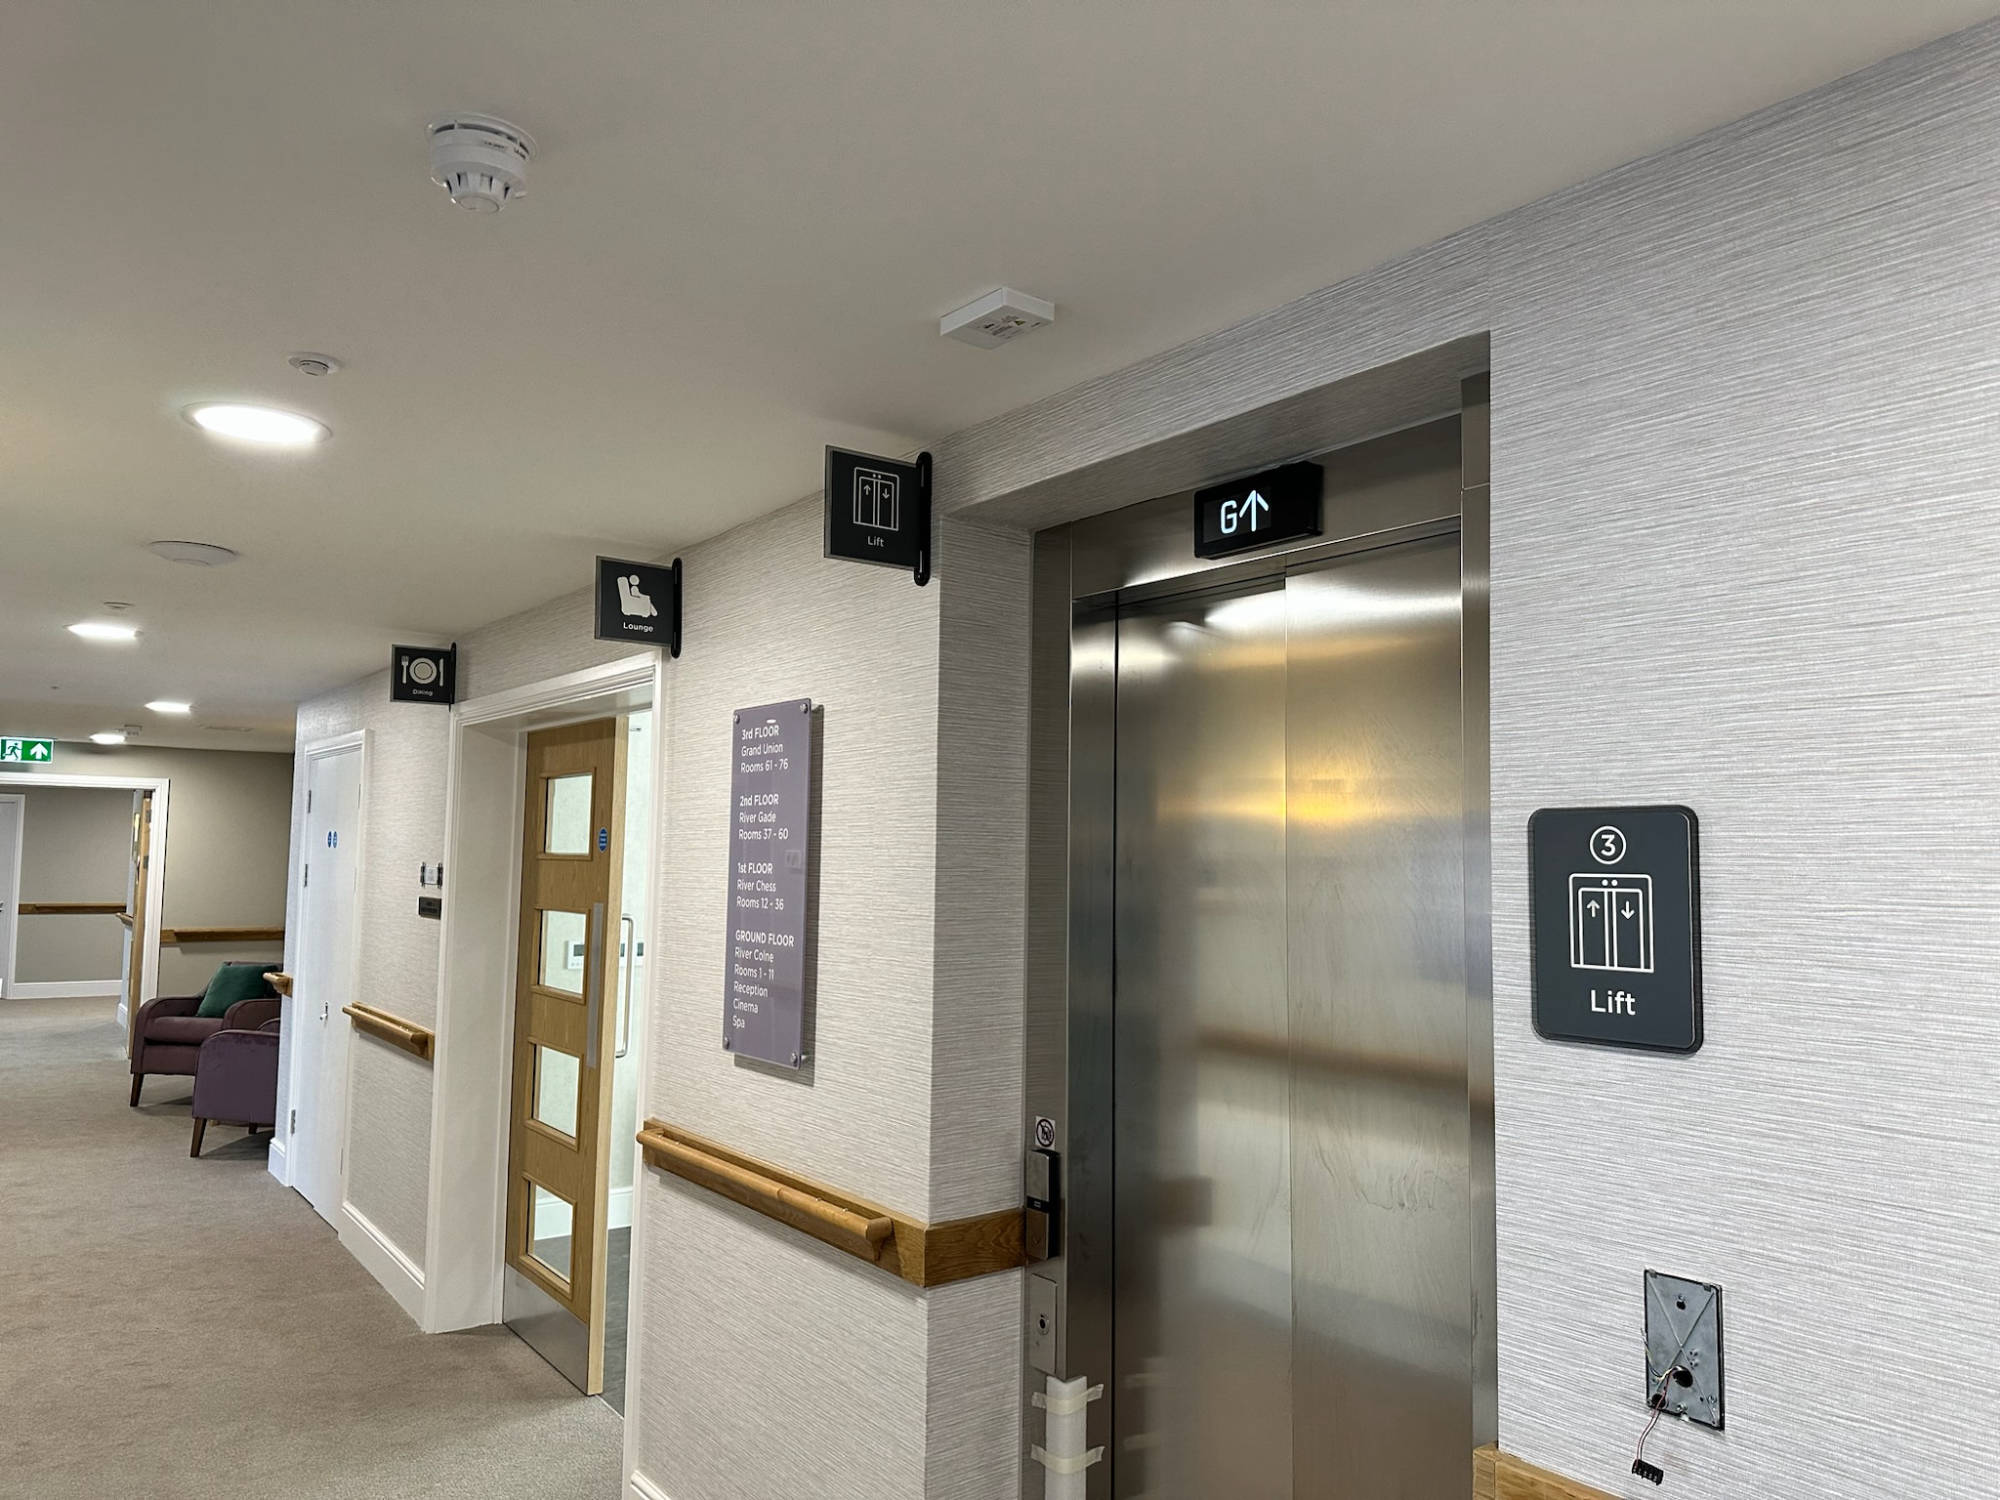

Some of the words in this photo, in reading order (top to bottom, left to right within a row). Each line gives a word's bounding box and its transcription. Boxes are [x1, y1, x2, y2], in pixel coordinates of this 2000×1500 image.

[1220, 499, 1238, 534] G
[867, 535, 885, 548] Lift
[623, 621, 654, 633] Lounge
[741, 728, 753, 740] 3rd
[754, 724, 780, 739] FLOOR
[741, 744, 762, 757] Grand
[763, 742, 784, 755] Union
[740, 762, 764, 773] Rooms
[765, 759, 773, 772] 61
[779, 757, 789, 770] 76
[739, 794, 753, 807] 2nd
[754, 793, 780, 806] FLOOR
[739, 811, 757, 823] River
[758, 810, 777, 823] Gade
[738, 828, 762, 840] Rooms
[763, 827, 773, 840] 37
[778, 827, 789, 840] 60
[1600, 834, 1616, 856] 3
[737, 861, 747, 874] 1st
[748, 862, 774, 875] FLOOR
[736, 878, 755, 891] River
[756, 879, 777, 892] Chess
[736, 895, 760, 909] Rooms
[761, 896, 769, 909] 12
[774, 897, 785, 911] 36
[735, 929, 767, 945] GROUND
[767, 932, 795, 948] FLOOR
[734, 946, 753, 960] River
[753, 948, 775, 963] Colne
[734, 963, 758, 979] Rooms
[758, 966, 762, 980] 1
[768, 967, 775, 981] 11
[733, 980, 769, 998] Reception
[733, 997, 759, 1014] Cinema
[1590, 989, 1636, 1016] Lift
[732, 1014, 745, 1029] Spa
